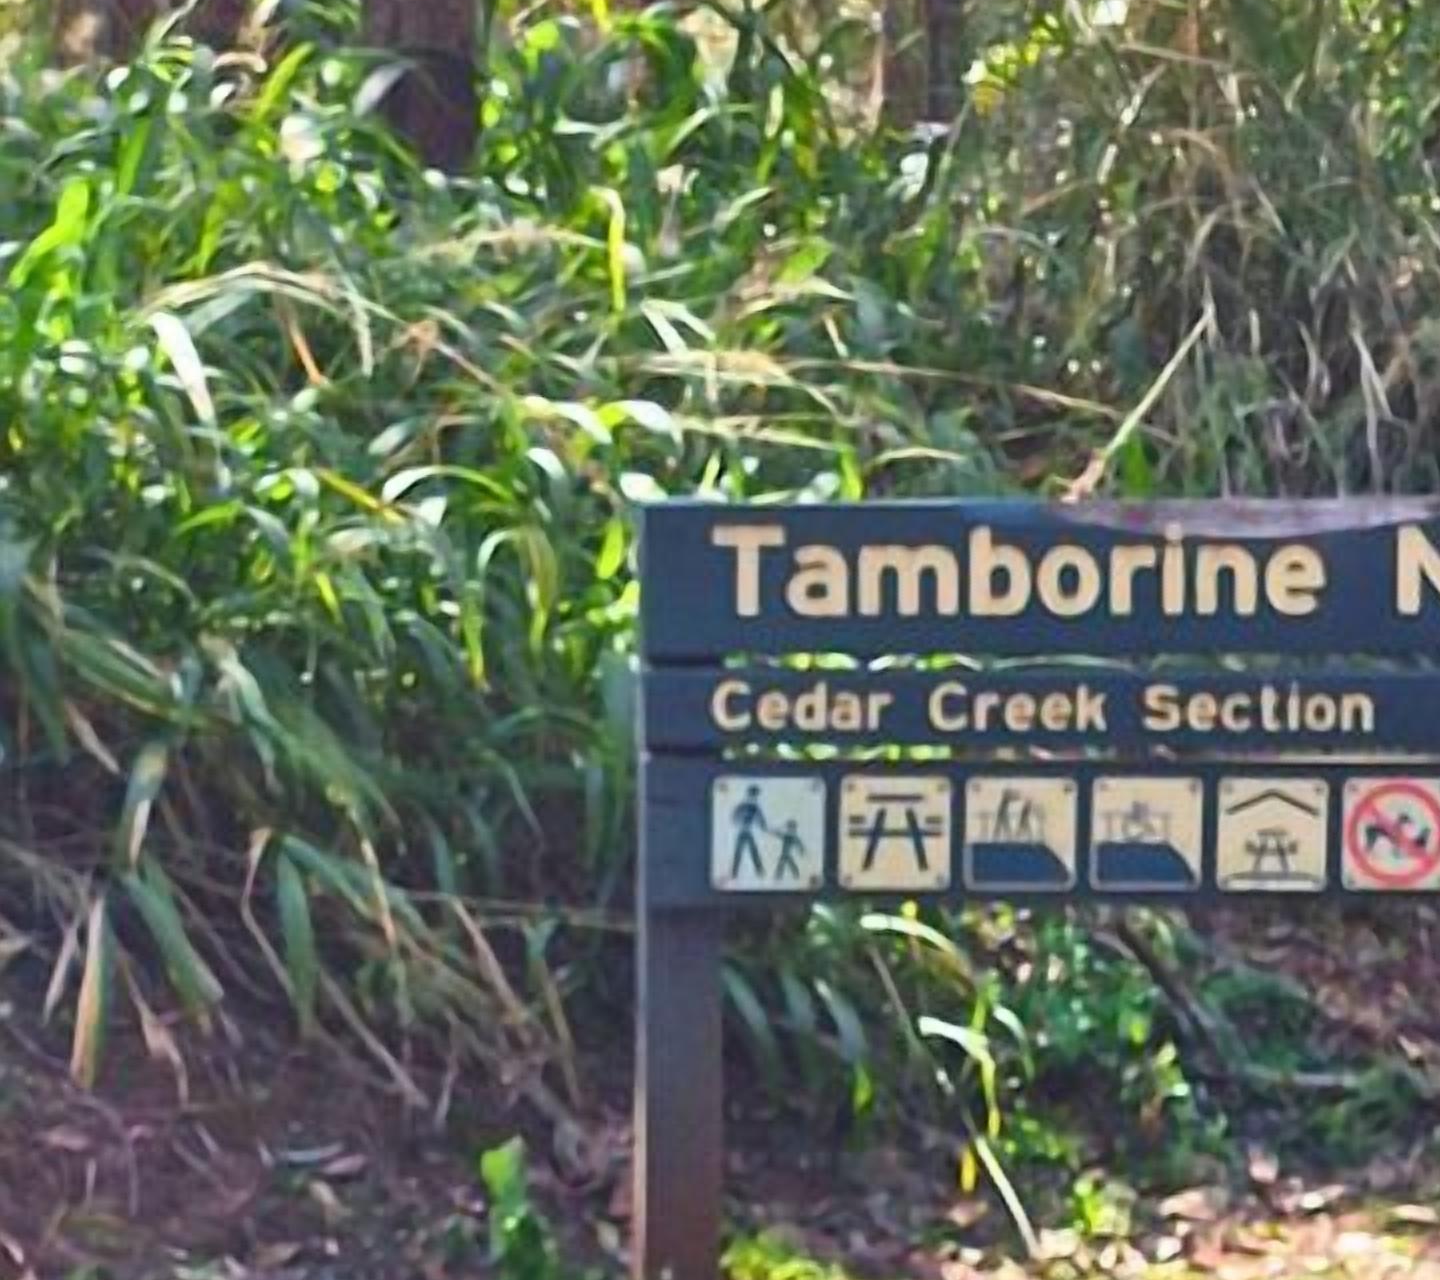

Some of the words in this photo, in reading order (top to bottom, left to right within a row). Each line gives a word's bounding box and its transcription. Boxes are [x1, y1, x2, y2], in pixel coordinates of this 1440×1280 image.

[711, 525, 1326, 617] Tamborine
[710, 680, 893, 732] Cedar
[928, 682, 1108, 732] Creek
[1142, 683, 1375, 733] Section
